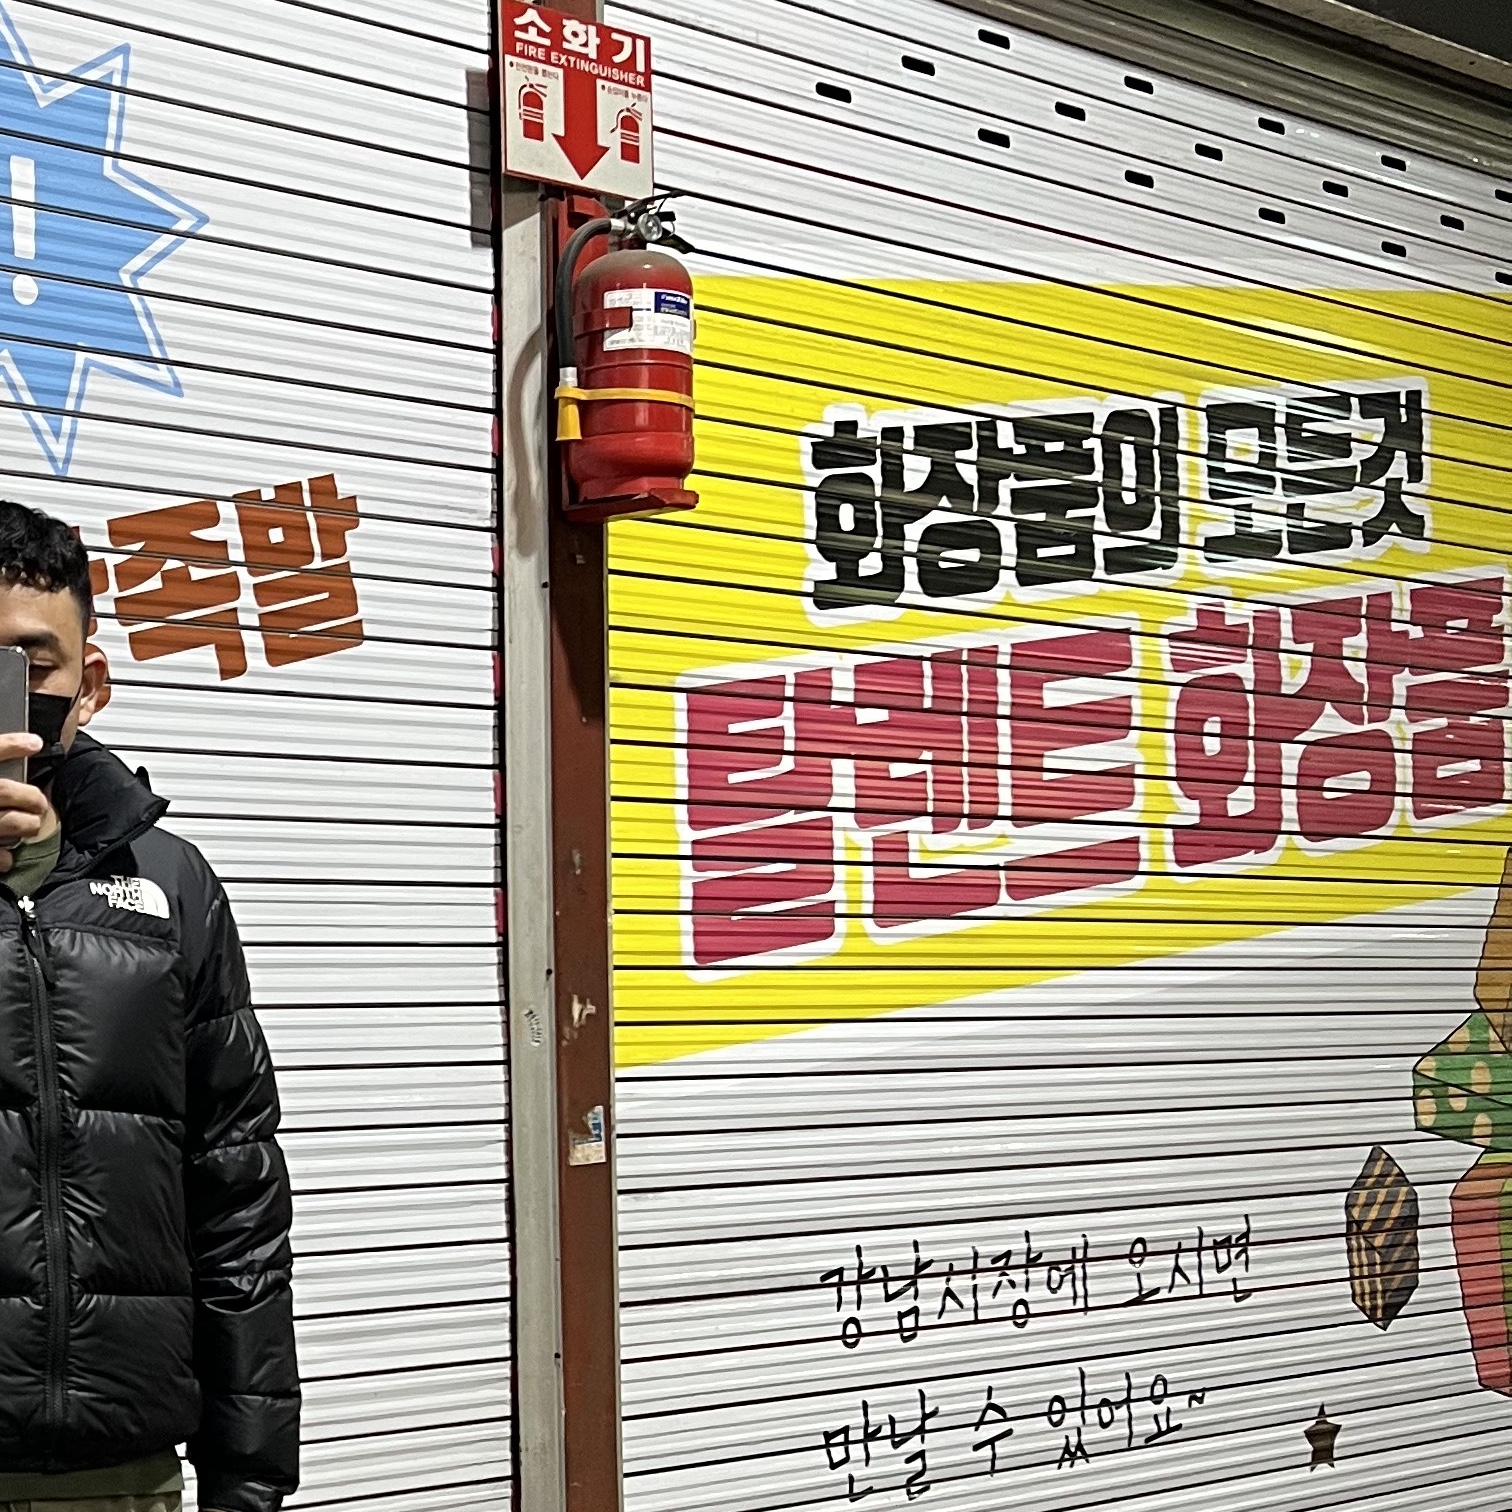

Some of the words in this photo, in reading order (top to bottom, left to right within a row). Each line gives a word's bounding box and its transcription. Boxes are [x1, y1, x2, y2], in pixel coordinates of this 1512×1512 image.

[513, 8, 645, 73] 소화기
[515, 42, 546, 61] FIRE
[550, 51, 646, 88] EXTINGUISHER
[810, 406, 1180, 611] 화장품의
[1201, 390, 1426, 562] 모든것
[686, 628, 1142, 966] 탈렌트
[1169, 575, 1510, 869] 화장품
[89, 882, 142, 902] NORTH
[108, 895, 145, 911] FACE
[110, 875, 141, 888] THE
[821, 1230, 1088, 1348] 강남시장에
[1124, 1213, 1253, 1304] 오시면
[823, 1389, 939, 1502] 만날
[973, 1386, 1014, 1477] 수
